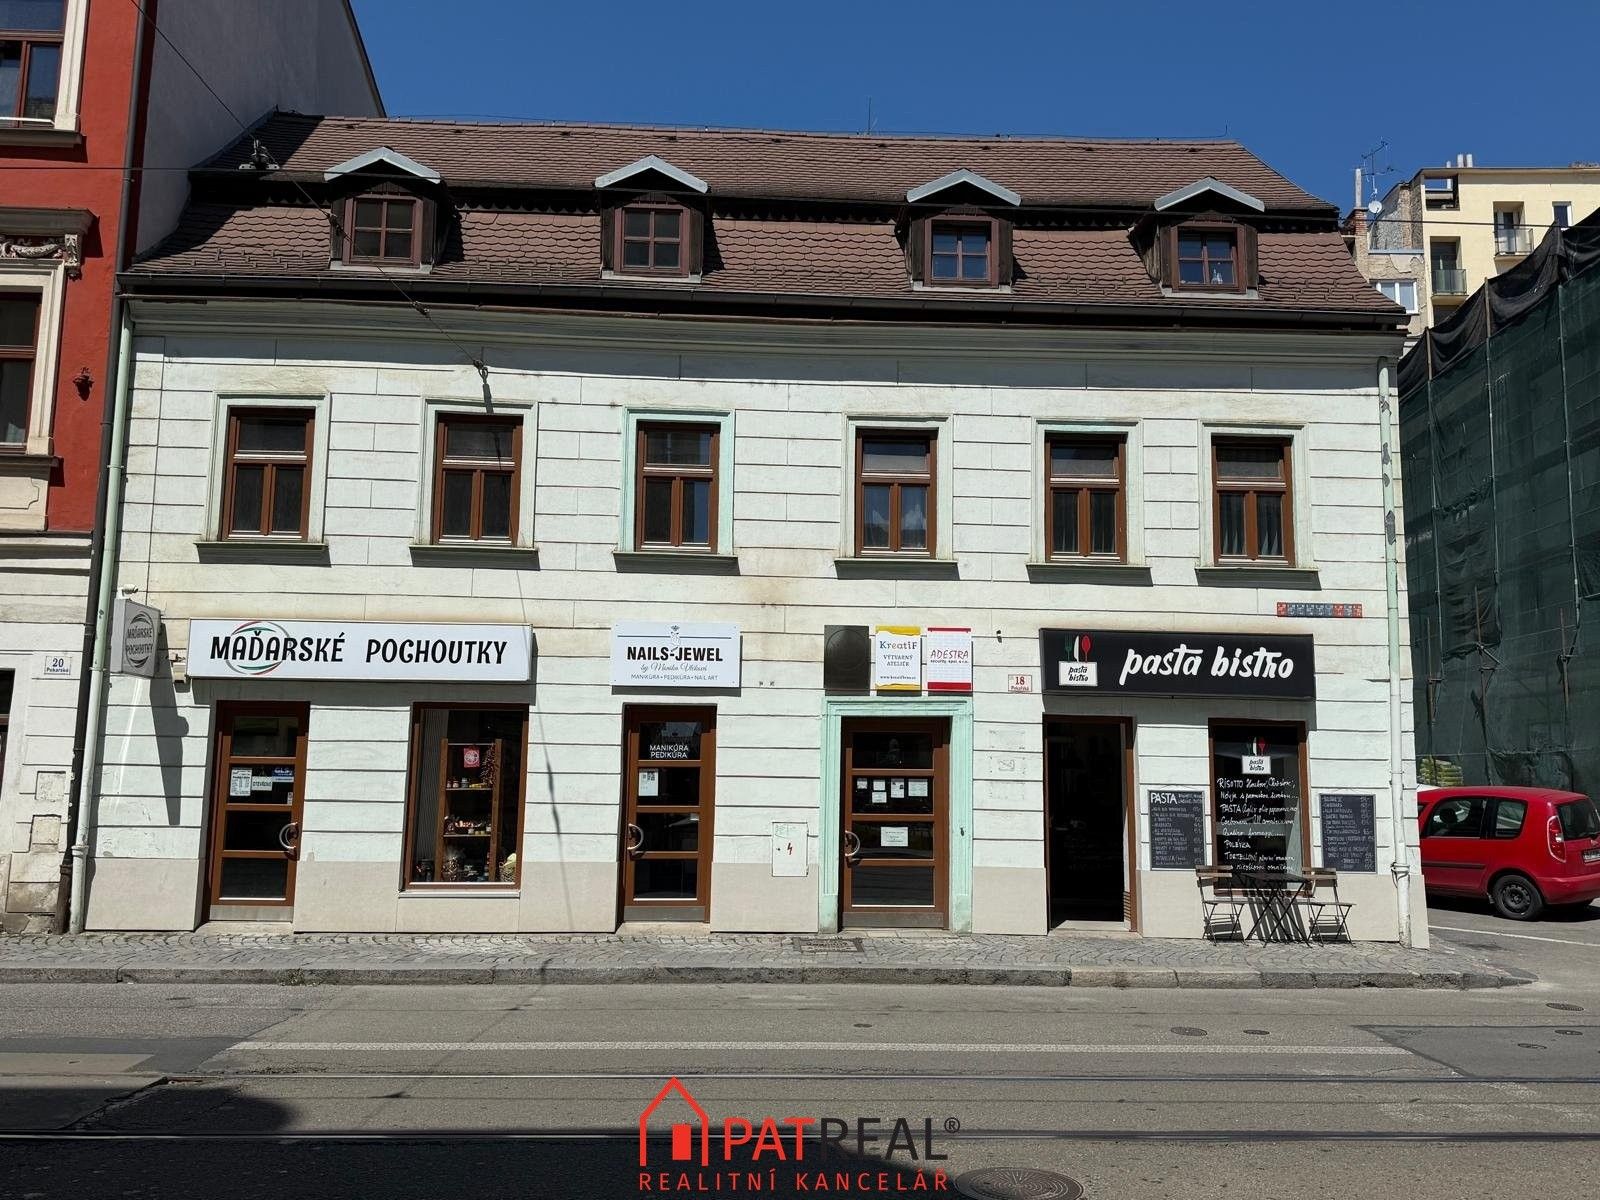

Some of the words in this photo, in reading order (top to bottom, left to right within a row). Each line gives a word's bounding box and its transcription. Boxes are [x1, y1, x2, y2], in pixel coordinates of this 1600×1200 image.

[210, 630, 345, 663] MAĎARSKÉ
[365, 638, 508, 665] POCHOUTKY
[879, 640, 918, 650] KreatiF
[626, 646, 724, 662] NAILS-JEWEL
[930, 649, 969, 660] ADESTRA
[52, 658, 64, 668] 20
[1118, 643, 1203, 686] pasta
[1210, 645, 1294, 679] bistro
[1067, 665, 1088, 675] pasta
[1015, 676, 1025, 685] 18
[1068, 674, 1089, 682] bistro
[649, 743, 689, 752] MANIKÚRA
[1249, 759, 1264, 767] pasta
[1150, 792, 1178, 804] PASTA
[1220, 803, 1242, 814] PASTA
